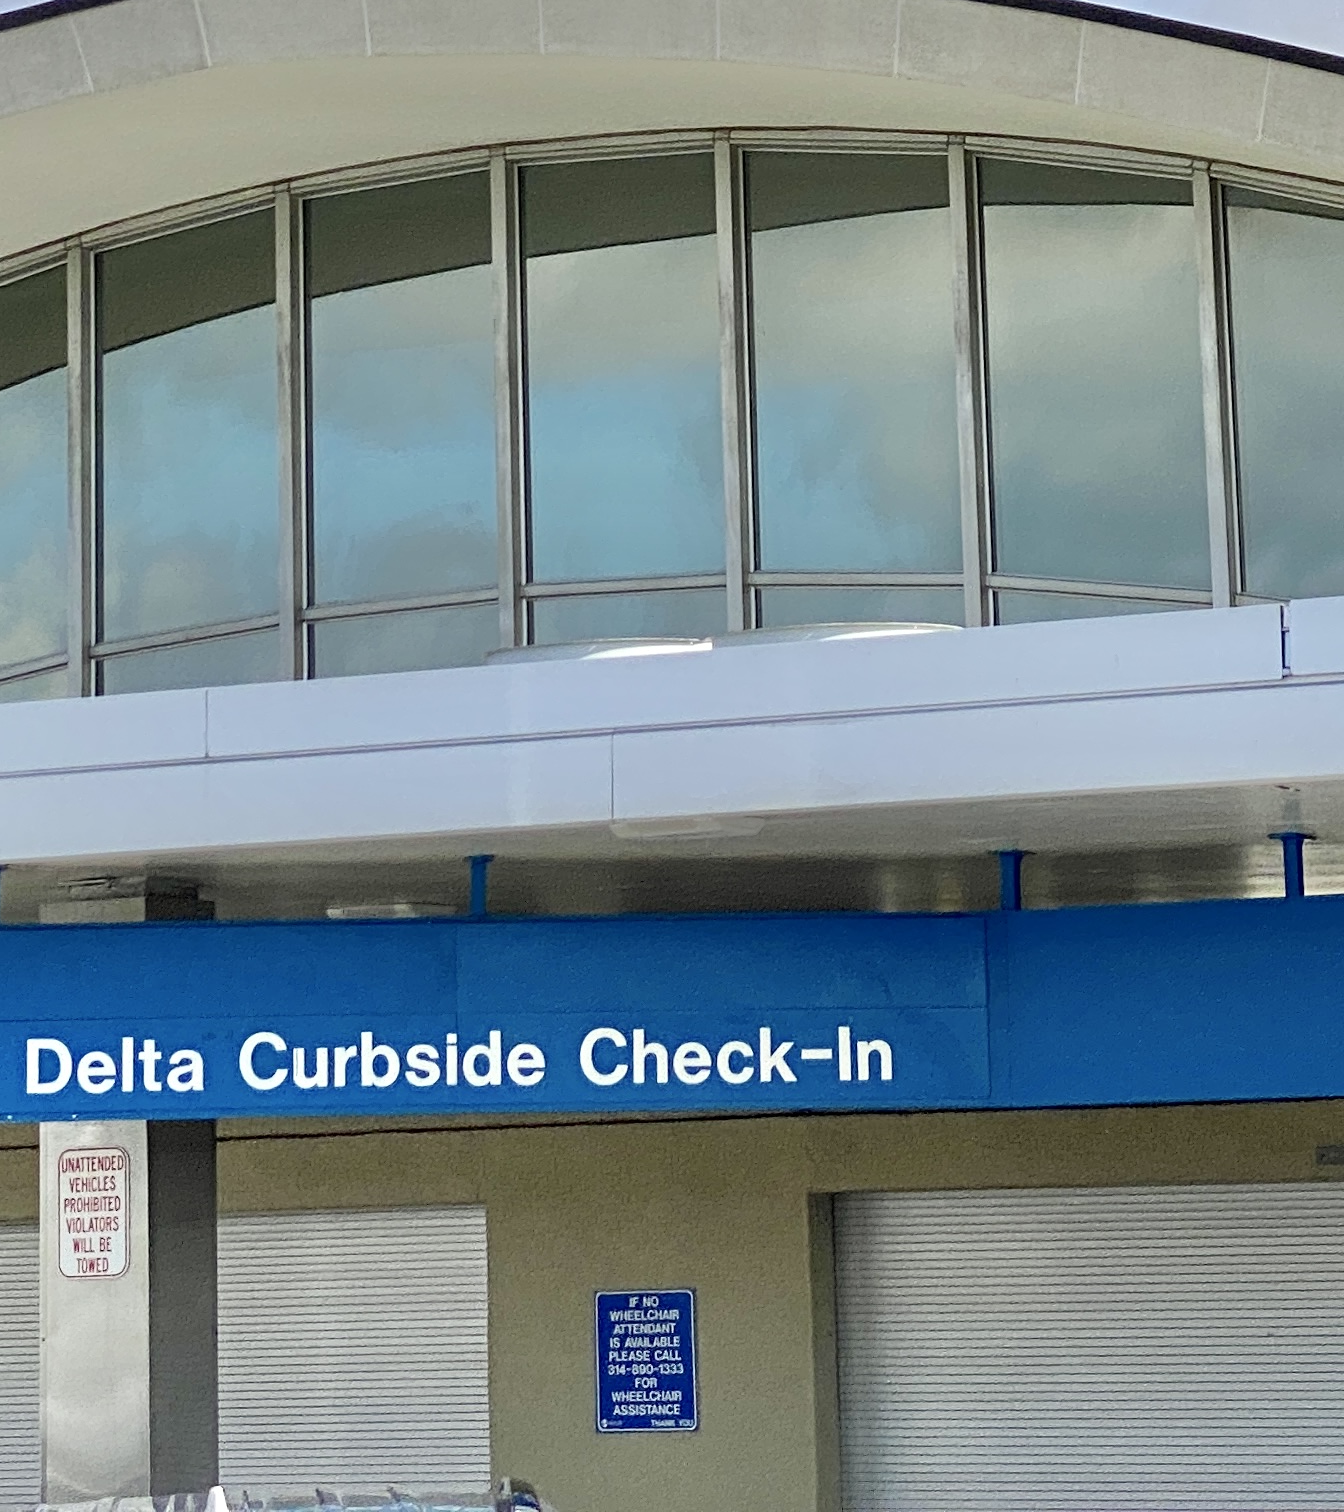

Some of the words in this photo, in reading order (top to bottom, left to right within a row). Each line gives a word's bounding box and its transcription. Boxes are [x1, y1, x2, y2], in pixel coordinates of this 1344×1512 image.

[26, 1036, 204, 1095] Delta
[239, 1030, 546, 1091] Curbside
[579, 1026, 893, 1086] Check-In
[61, 1155, 124, 1173] UNATTENDED
[69, 1175, 116, 1193] VEHICLES
[64, 1195, 121, 1213] PROHIBITED
[66, 1216, 119, 1234] VIOLATORS
[72, 1238, 95, 1253] WILL
[99, 1237, 112, 1252] BE
[76, 1258, 109, 1273] TOWED
[629, 1297, 639, 1308] IF
[643, 1296, 659, 1307] NO
[609, 1309, 679, 1322] WHEELCHAIR
[613, 1323, 676, 1335] ATTENDANT
[609, 1337, 620, 1348] IS
[624, 1336, 681, 1348] AVAILABLE
[608, 1350, 651, 1362] PLEASE
[654, 1350, 682, 1361] CALL
[607, 1363, 684, 1376] 314-890-1333
[634, 1377, 658, 1388] FOR
[611, 1390, 682, 1402] WHEELCHAIR
[613, 1404, 681, 1416] ASSISTANCE
